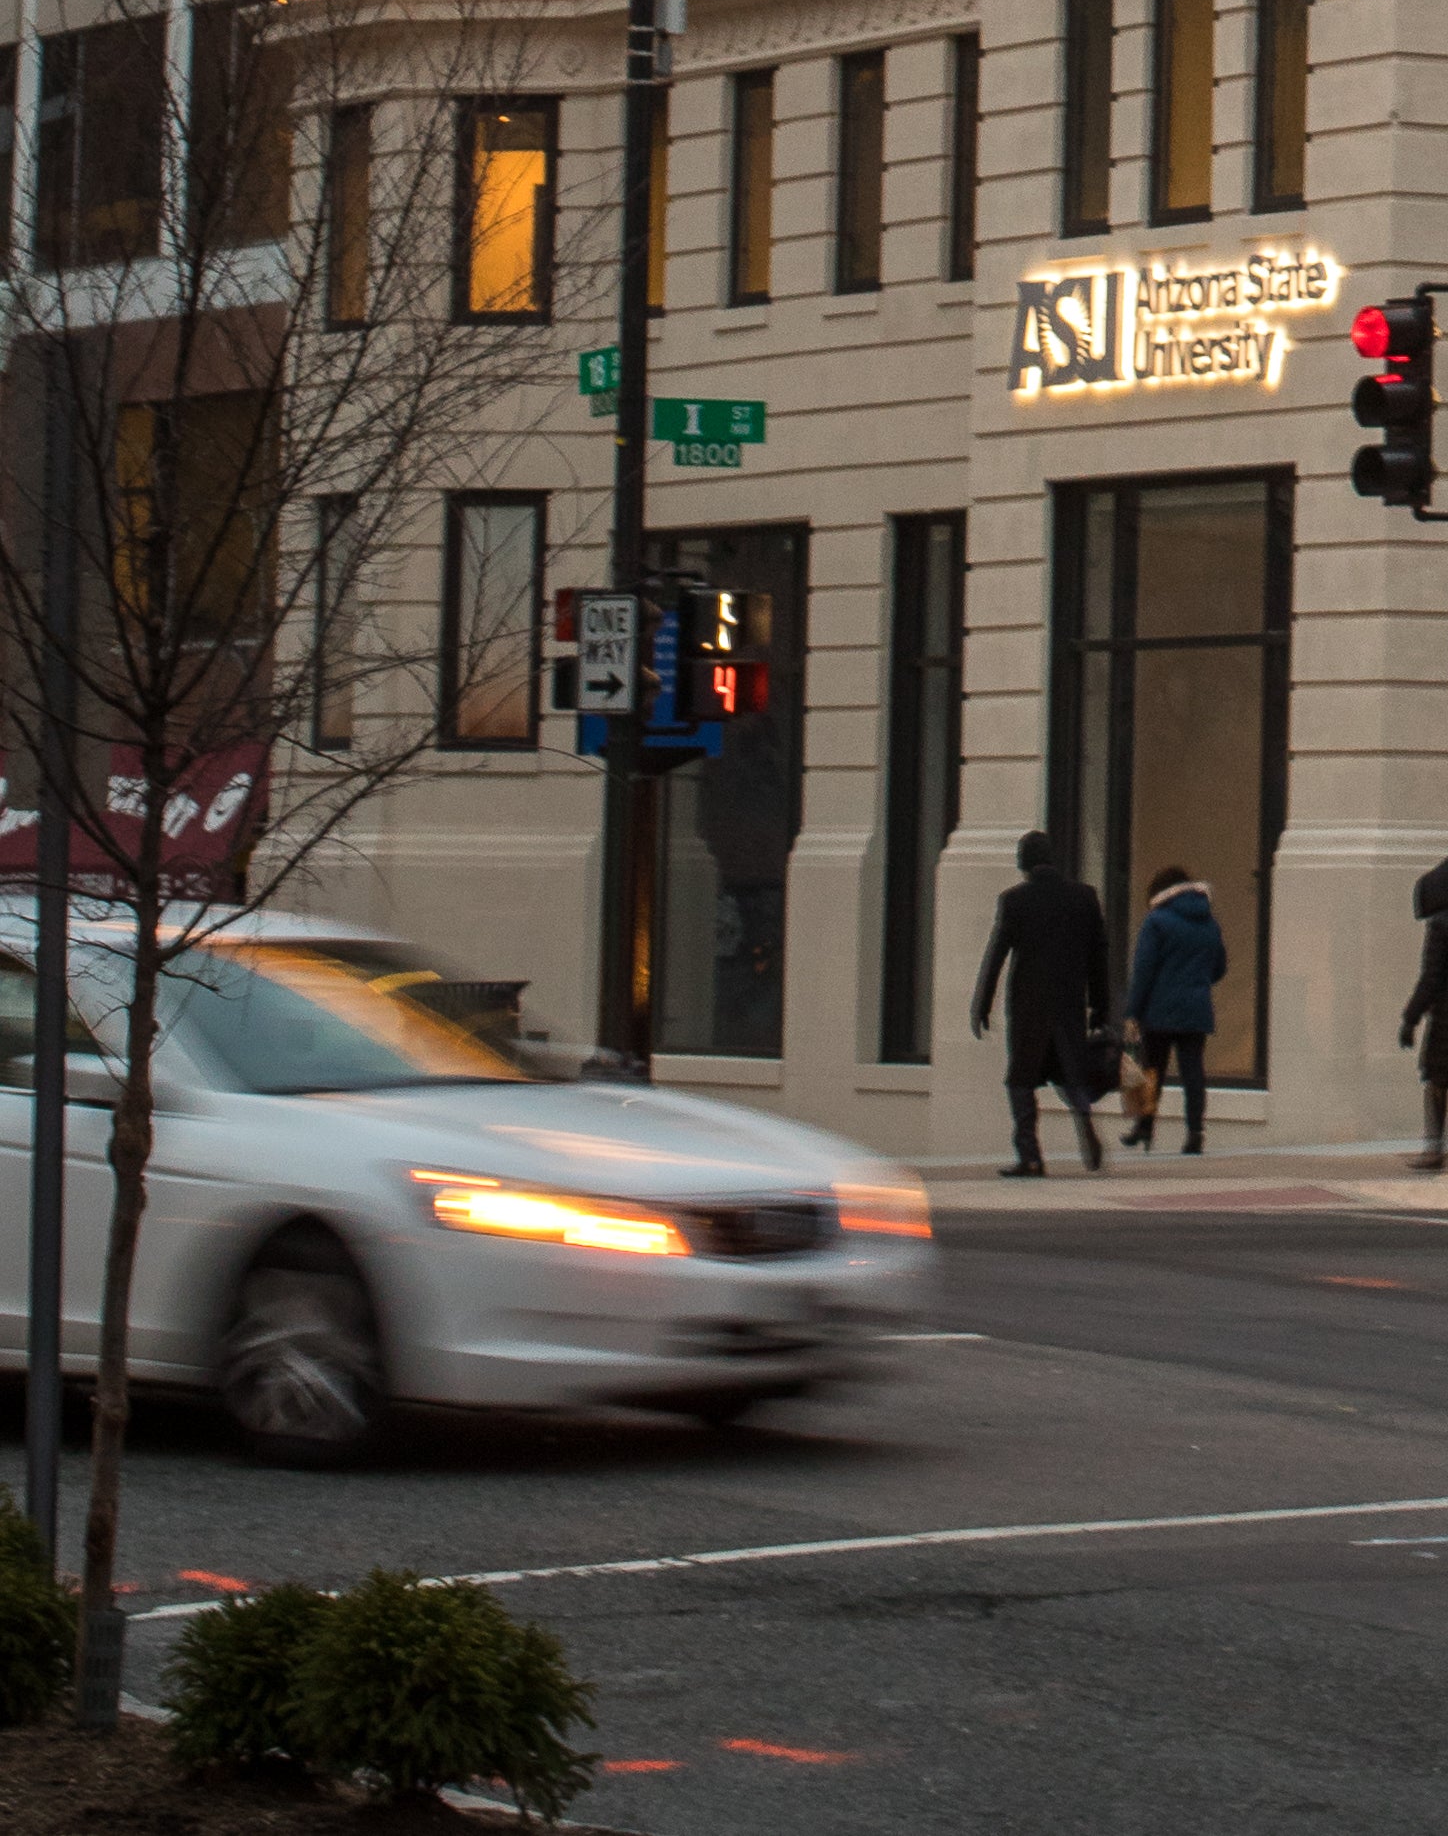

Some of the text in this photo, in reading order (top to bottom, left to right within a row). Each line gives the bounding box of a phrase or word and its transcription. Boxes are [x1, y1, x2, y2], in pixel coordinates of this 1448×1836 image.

[1137, 253, 1328, 316] Arizona State
[1006, 272, 1119, 391] ASU
[1135, 321, 1276, 380] University
[683, 404, 703, 436] I
[676, 443, 738, 465] 1800
[587, 608, 630, 634] ONE
[585, 639, 629, 664] WAY
